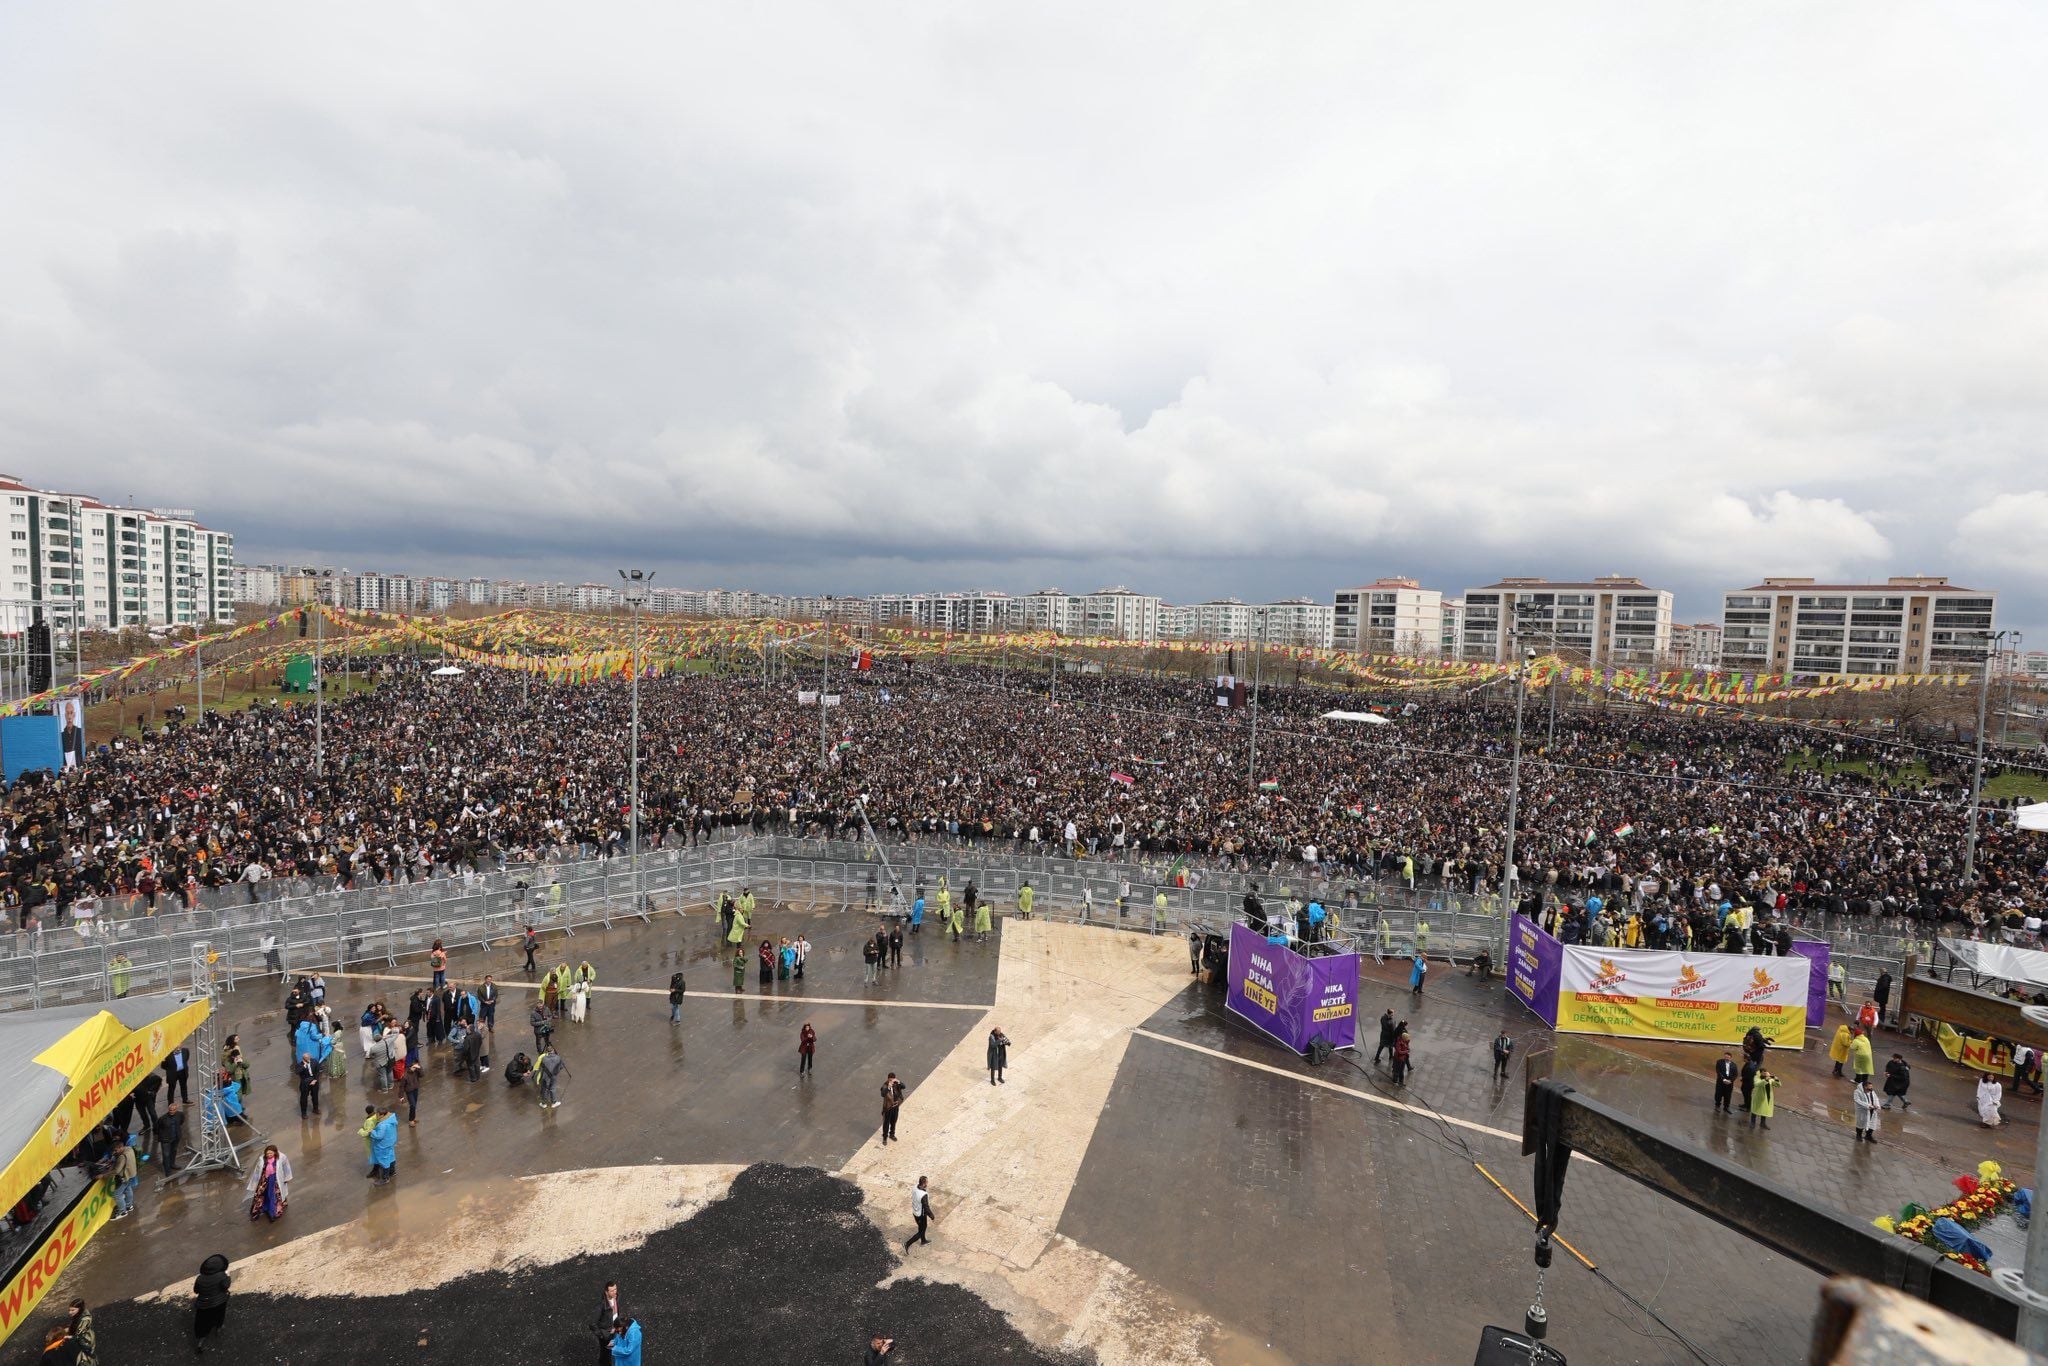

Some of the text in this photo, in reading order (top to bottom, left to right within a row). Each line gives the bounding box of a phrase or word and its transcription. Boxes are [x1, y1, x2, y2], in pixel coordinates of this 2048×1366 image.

[1251, 953, 1272, 974] NIHA
[1249, 969, 1273, 992] DEMA
[1325, 984, 1343, 994] NIKA
[1590, 974, 1626, 990] NEWROZ
[1671, 979, 1707, 996] NEWROZ
[1743, 983, 1780, 1001] NEWROZ
[1264, 997, 1275, 1011] YE
[1656, 1000, 1694, 1008] NEWROZA
[1736, 1026, 1780, 1036] NEOZU
[79, 1044, 144, 1118] NEWROZ
[81, 1176, 116, 1231] 2026
